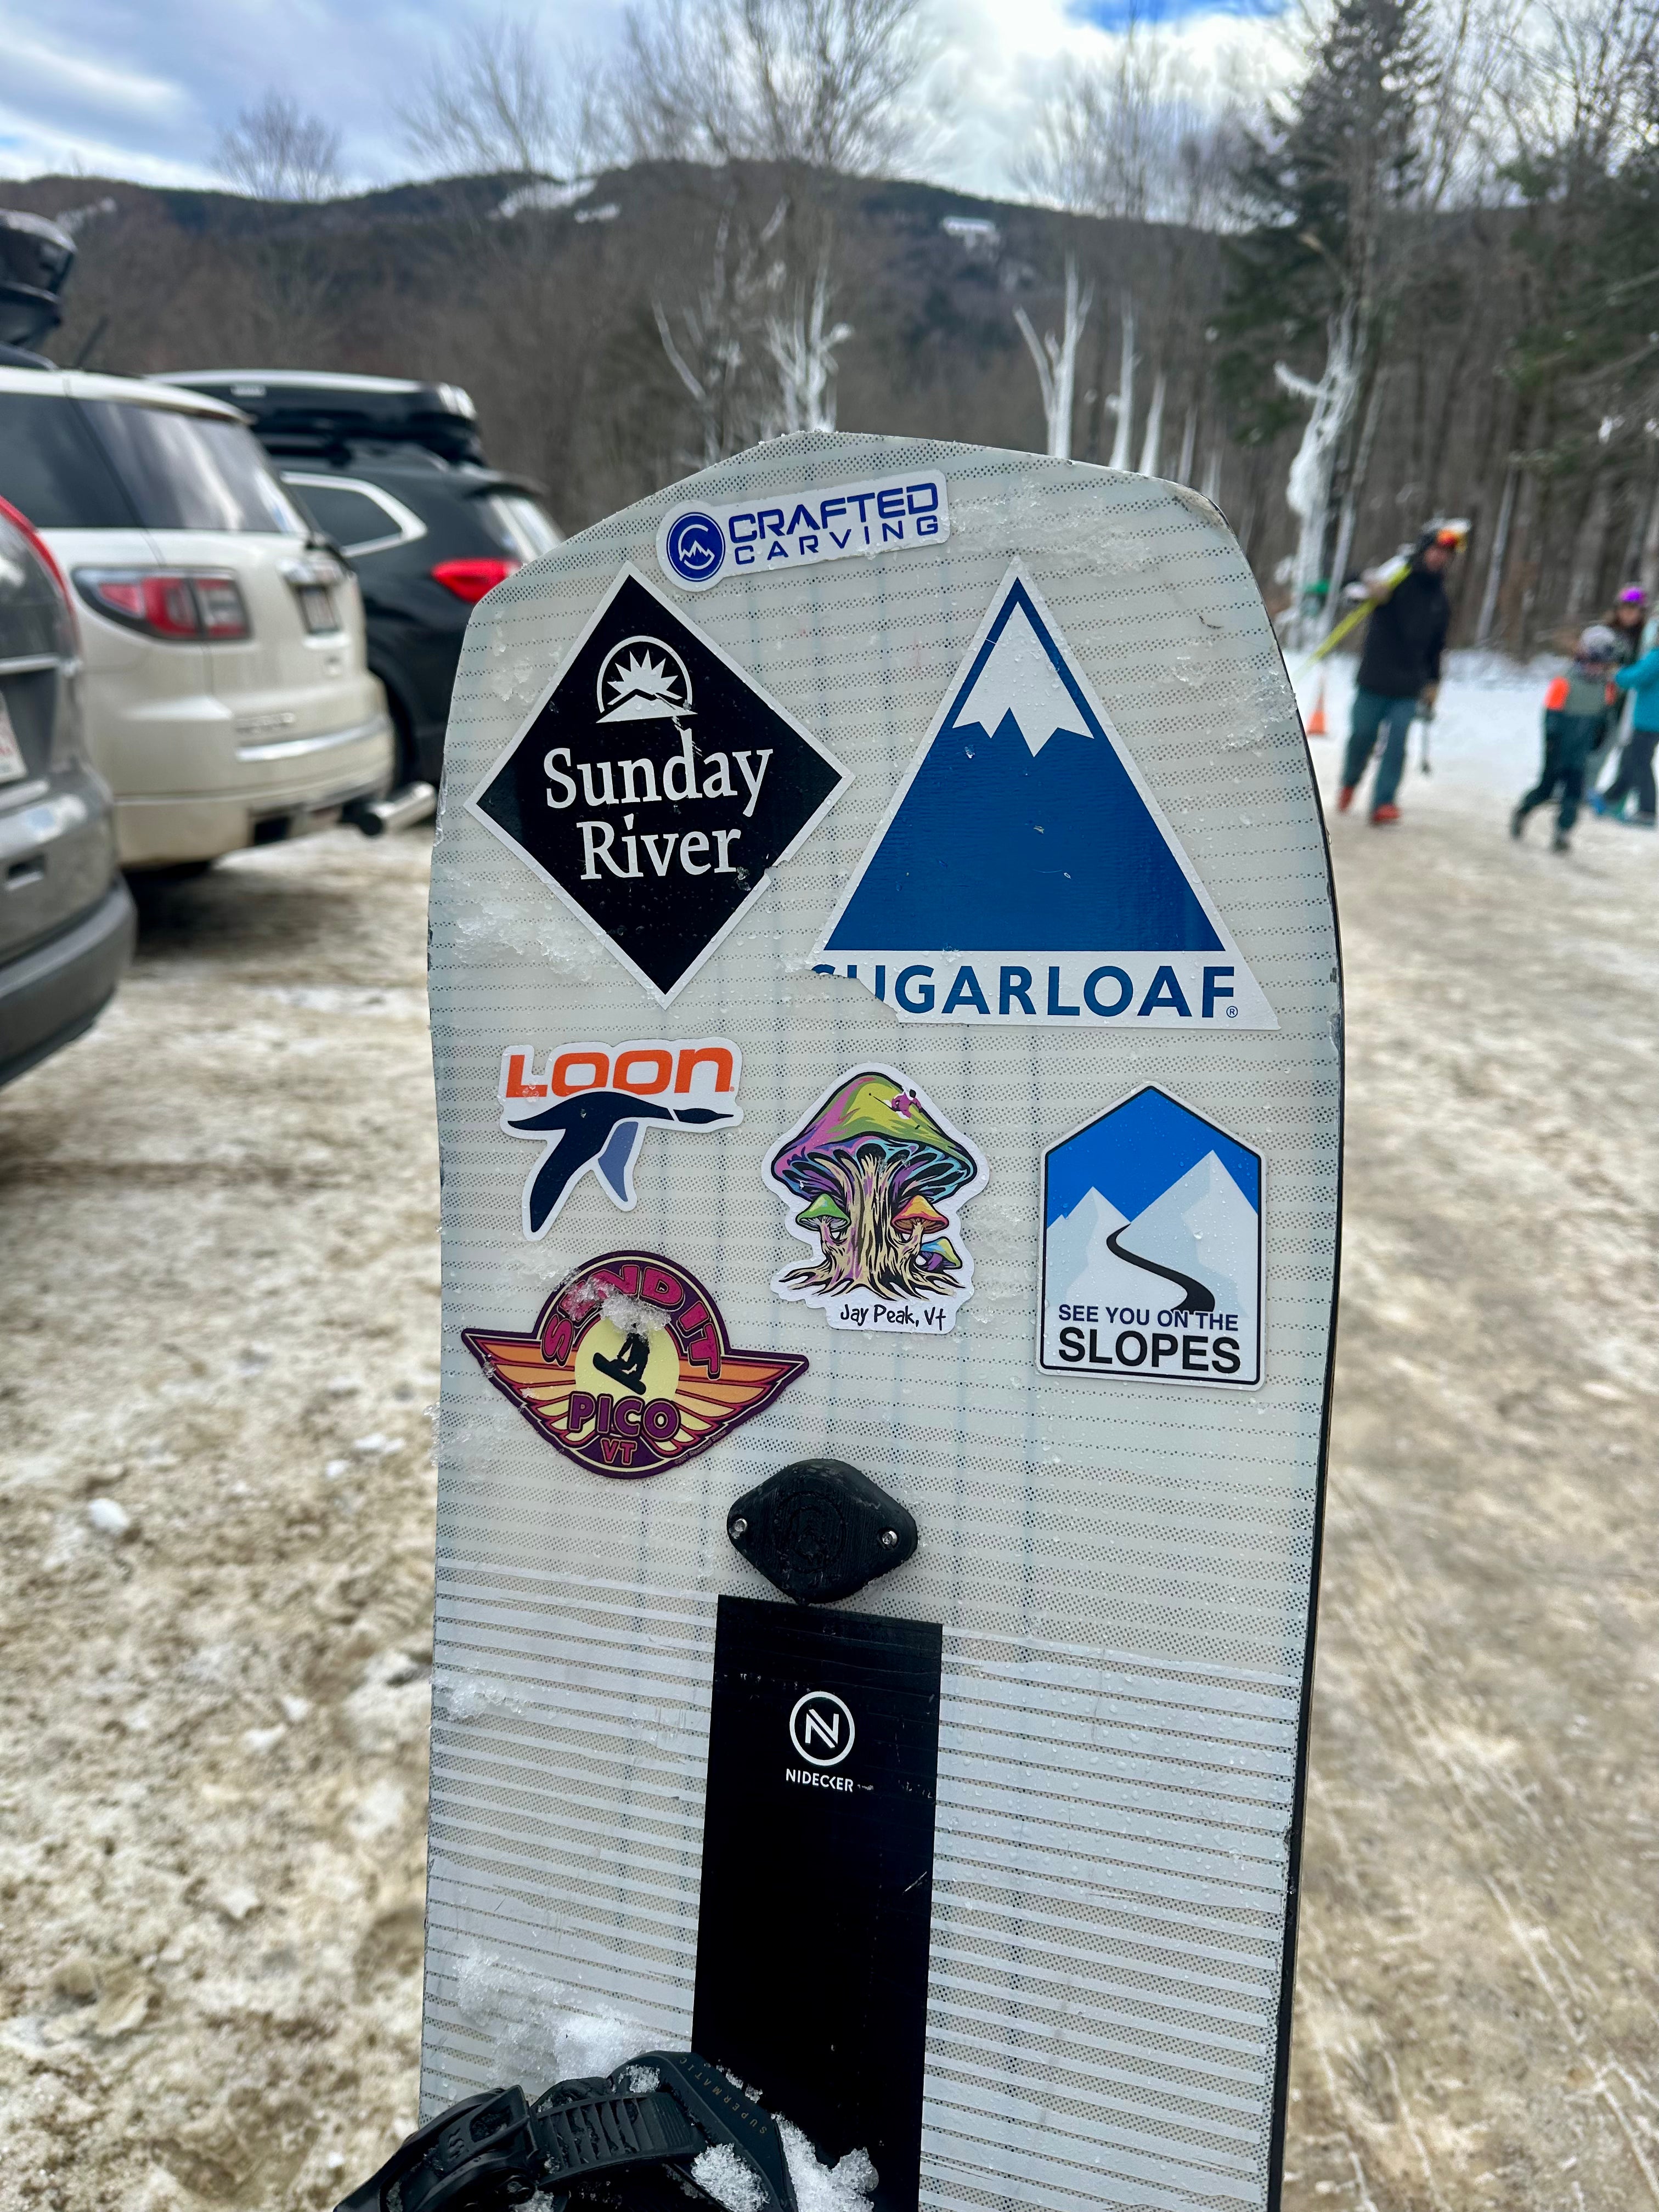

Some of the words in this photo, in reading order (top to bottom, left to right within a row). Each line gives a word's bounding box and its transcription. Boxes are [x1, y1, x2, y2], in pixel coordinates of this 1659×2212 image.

[729, 482, 939, 544] CRAFTED
[734, 515, 939, 565] CARVING
[543, 727, 774, 817] Sunday
[576, 814, 742, 881] River
[811, 963, 1238, 1018] GARLOAF®
[678, 1300, 721, 1377] IT
[840, 1304, 869, 1327] Jay
[873, 1304, 919, 1328] Peak,
[1058, 1304, 1099, 1323] SEE
[1105, 1307, 1150, 1326] YOU
[1156, 1310, 1188, 1328] ON
[1195, 1312, 1239, 1331] THE
[1058, 1327, 1241, 1374] SLOPES
[568, 1392, 680, 1441] PICO
[600, 1437, 638, 1465] VT
[786, 1768, 854, 1792] NIDECKER
[680, 2057, 767, 2134] SUPERMATIC
